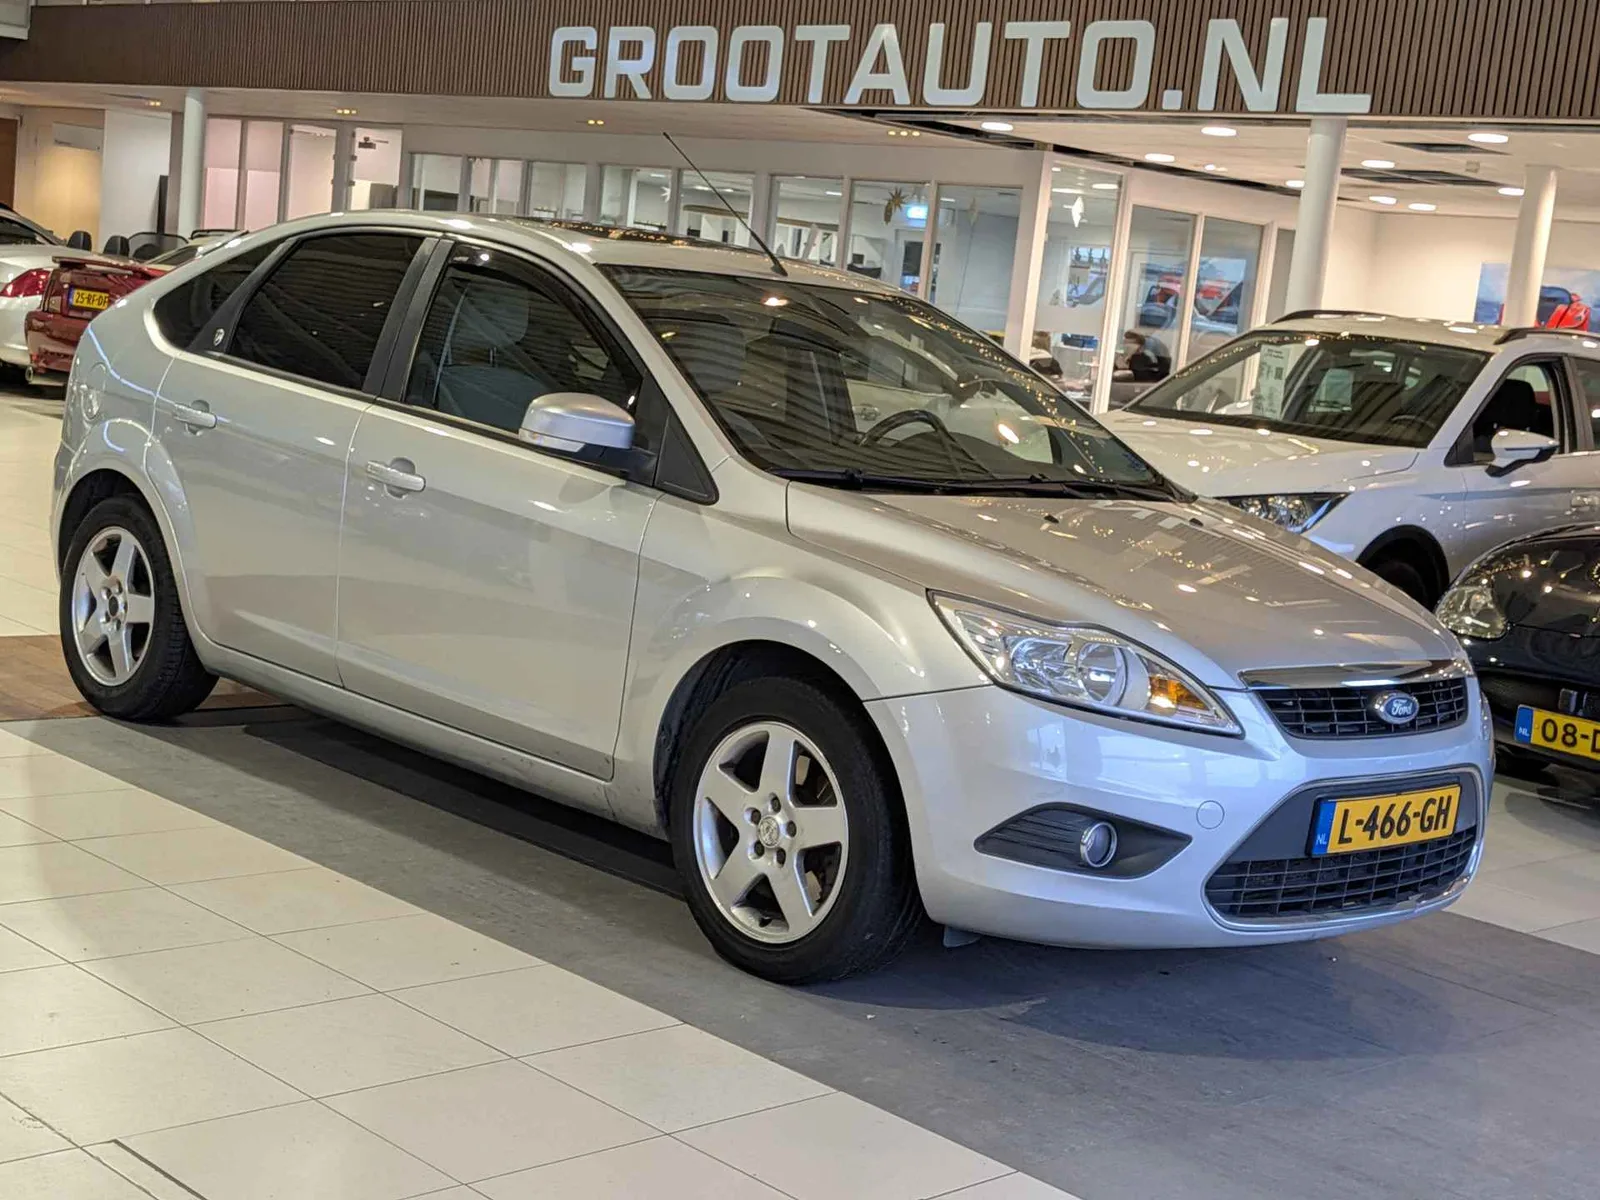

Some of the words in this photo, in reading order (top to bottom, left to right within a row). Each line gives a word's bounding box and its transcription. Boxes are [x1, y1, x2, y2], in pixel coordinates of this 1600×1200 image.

[549, 17, 1372, 113] GROOTAUTO.NL
[1391, 699, 1413, 716] Ford
[1518, 727, 1530, 737] NL
[1338, 795, 1452, 844] L-466-GH
[1315, 833, 1327, 845] NL
